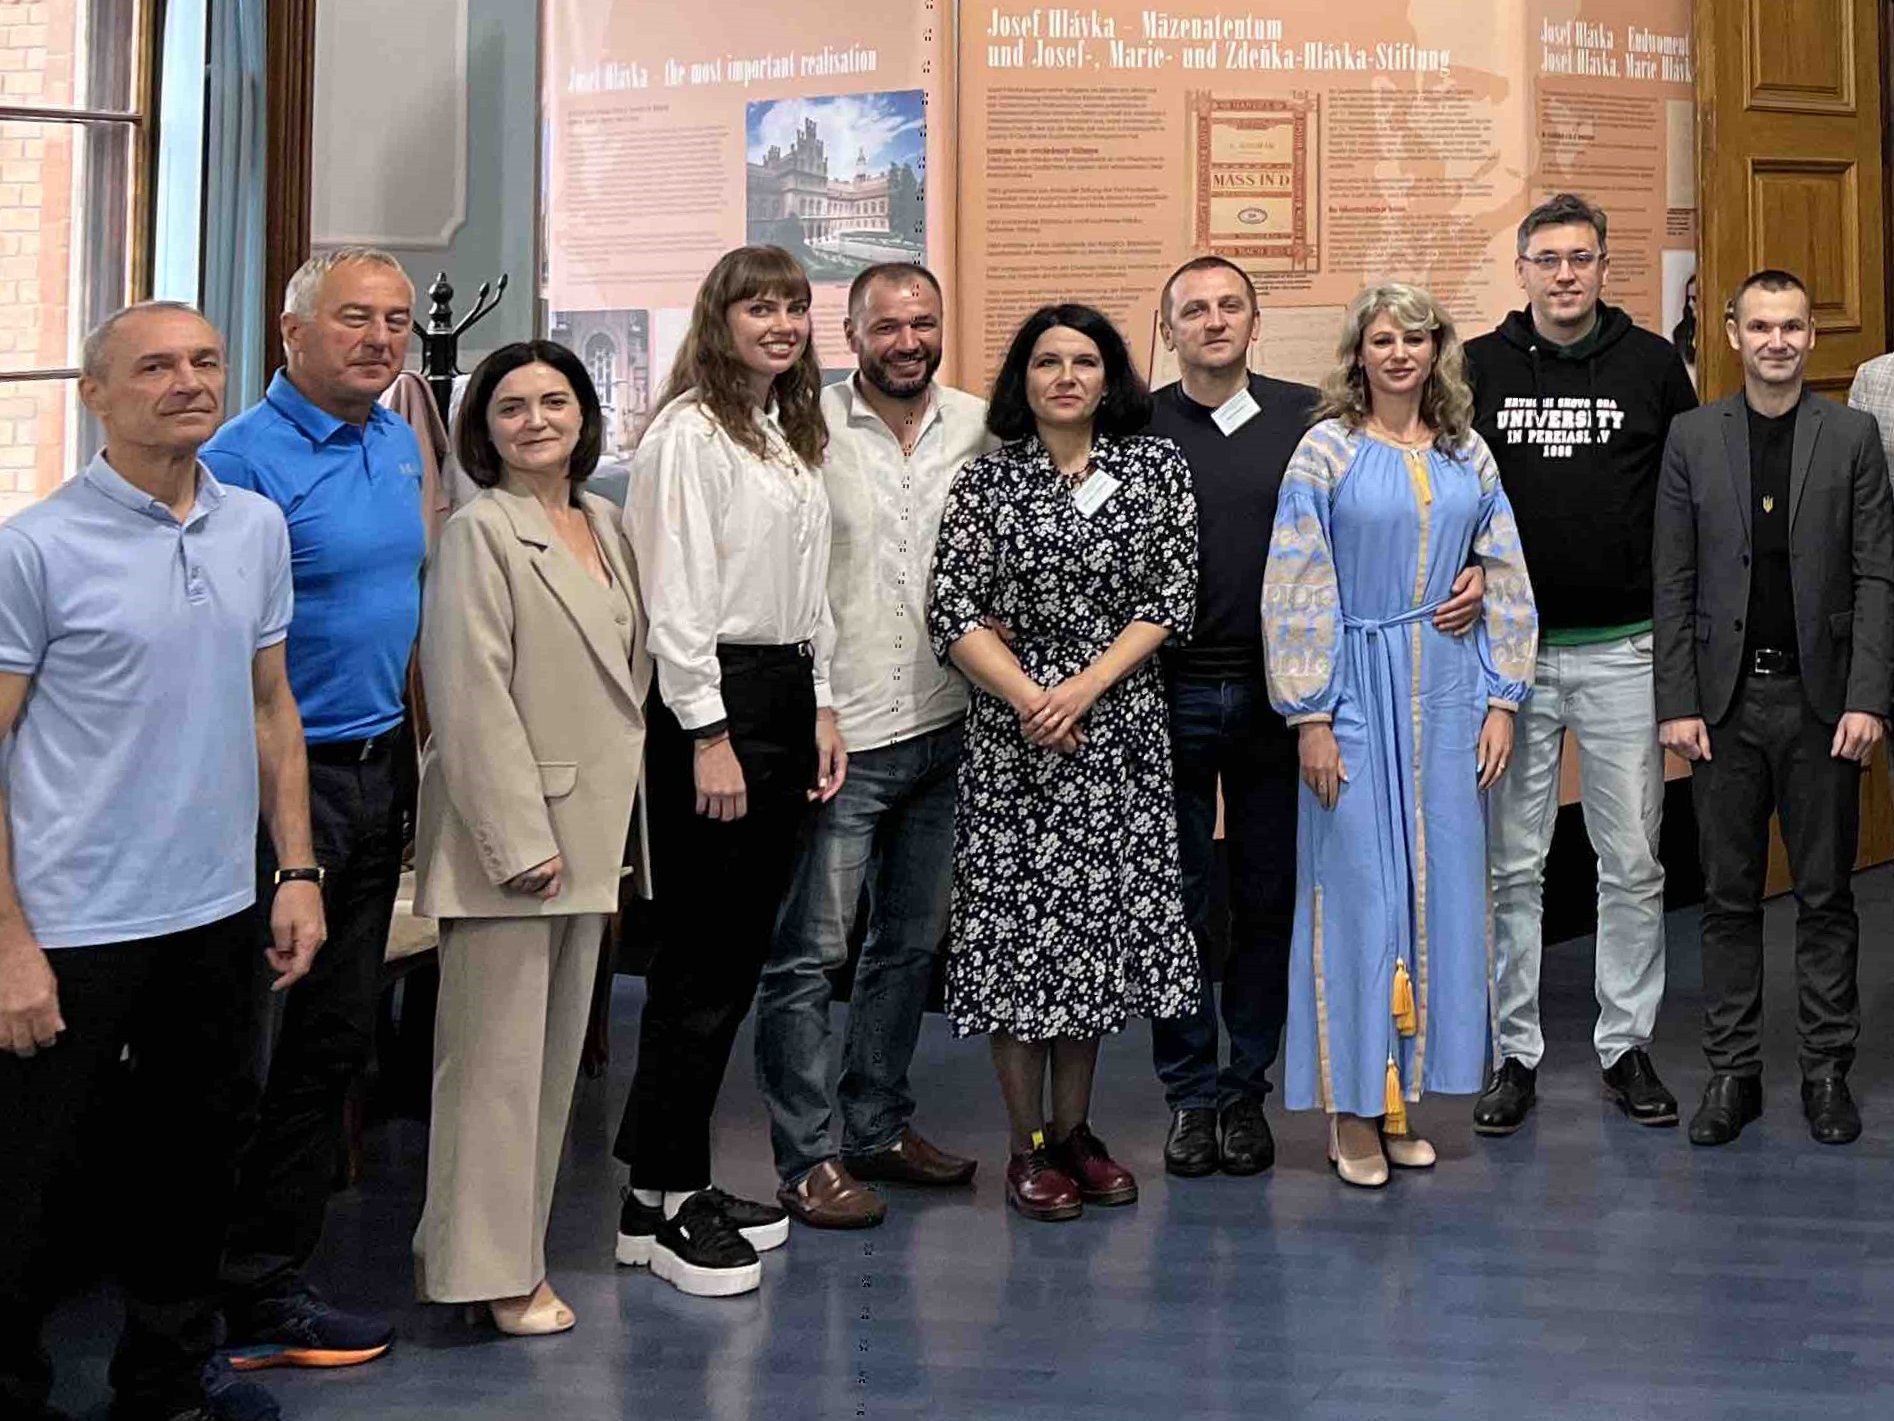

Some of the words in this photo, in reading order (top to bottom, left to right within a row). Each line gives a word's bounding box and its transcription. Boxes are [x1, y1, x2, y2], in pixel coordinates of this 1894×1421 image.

[987, 7, 1041, 38] Josef
[1049, 8, 1116, 39] Hlávka
[1541, 17, 1571, 47] Josef
[664, 57, 686, 87] the
[690, 56, 721, 86] most
[727, 49, 795, 88] important
[801, 42, 877, 77] realisation
[988, 38, 1024, 68] und
[1110, 39, 1173, 69] Marie-
[1182, 40, 1218, 70] und
[1541, 45, 1572, 73] Josef
[1625, 52, 1657, 80] Marie
[1214, 174, 1255, 186] MASS
[1261, 174, 1274, 186] IN
[1279, 174, 1290, 187] D
[1496, 409, 1625, 429] UNIVERSITY
[1527, 429, 1611, 444] PEREIASLV
